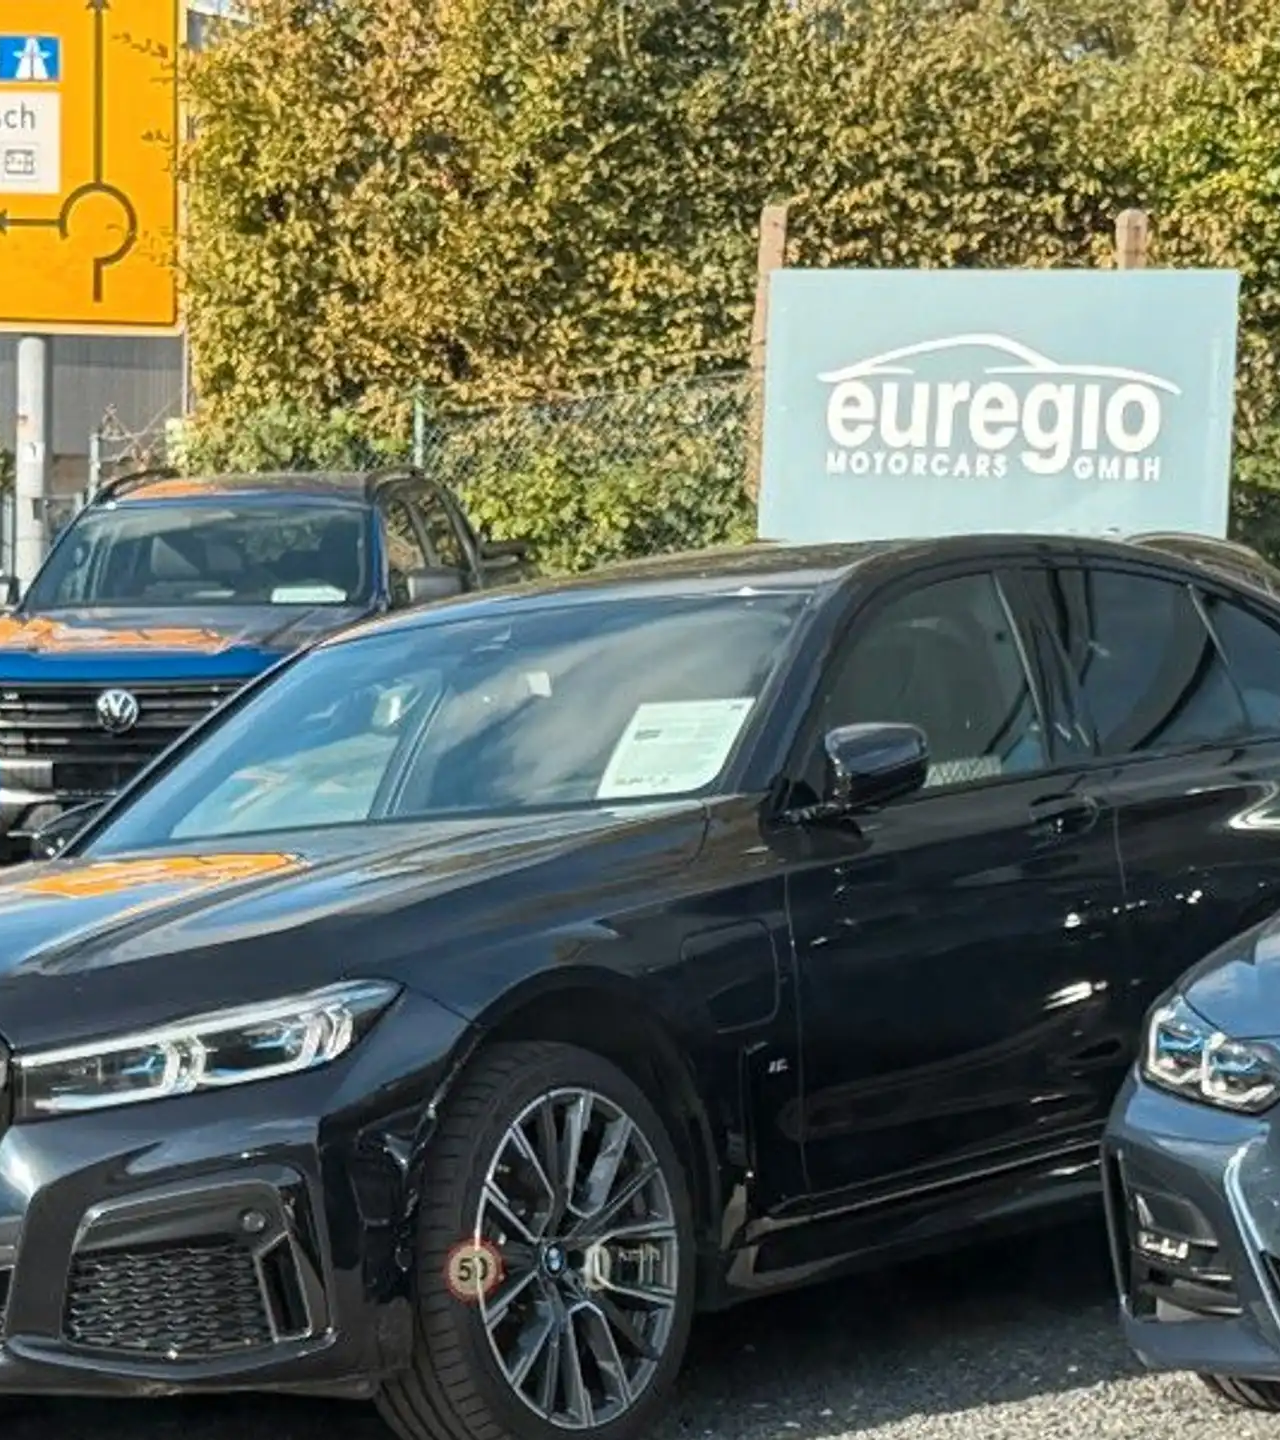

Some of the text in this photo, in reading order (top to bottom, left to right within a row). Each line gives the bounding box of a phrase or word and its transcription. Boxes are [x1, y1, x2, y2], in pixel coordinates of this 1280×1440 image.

[826, 380, 1162, 474] euregio
[825, 451, 1162, 481] MOTORCARS GMBH
